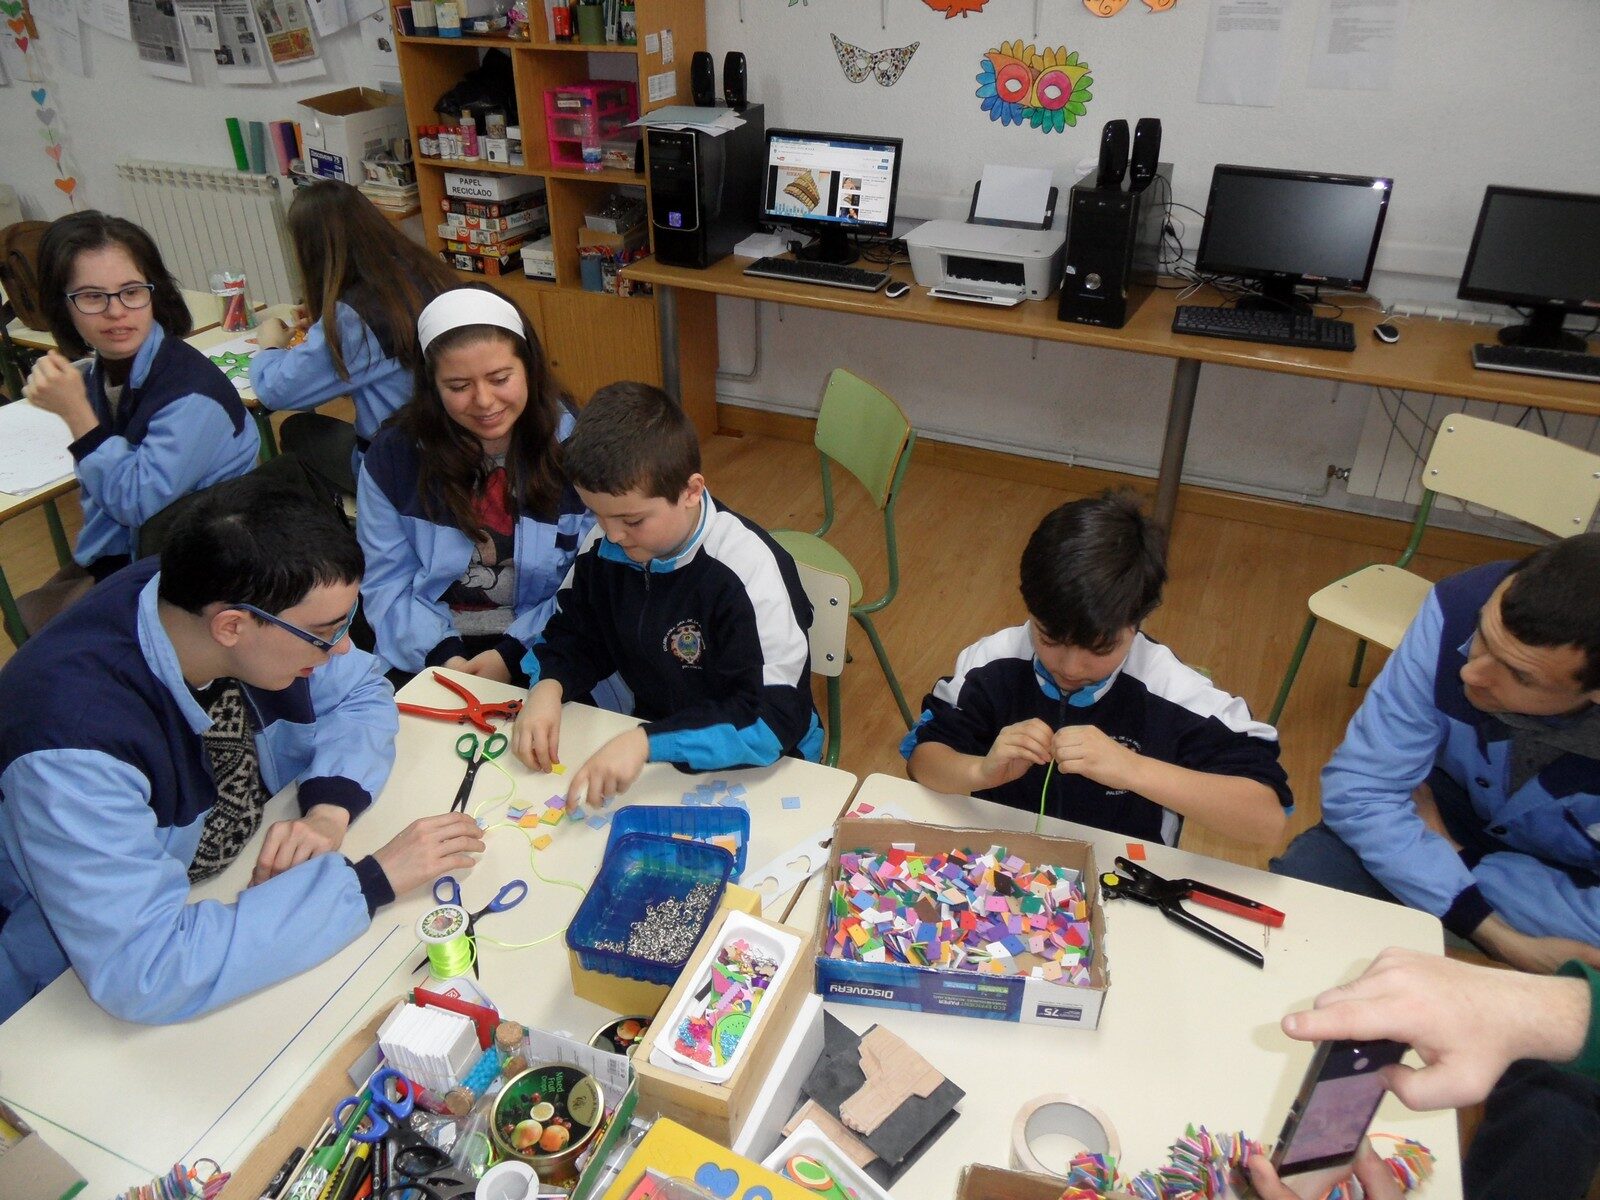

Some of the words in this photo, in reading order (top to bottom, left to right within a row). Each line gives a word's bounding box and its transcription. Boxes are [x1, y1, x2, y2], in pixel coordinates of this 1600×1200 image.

[459, 177, 482, 187] PAPEL
[452, 186, 492, 197] RECICLADO
[829, 984, 894, 999] DISCOVERY
[1043, 1008, 1059, 1017] 75
[555, 1071, 564, 1093] Mixed
